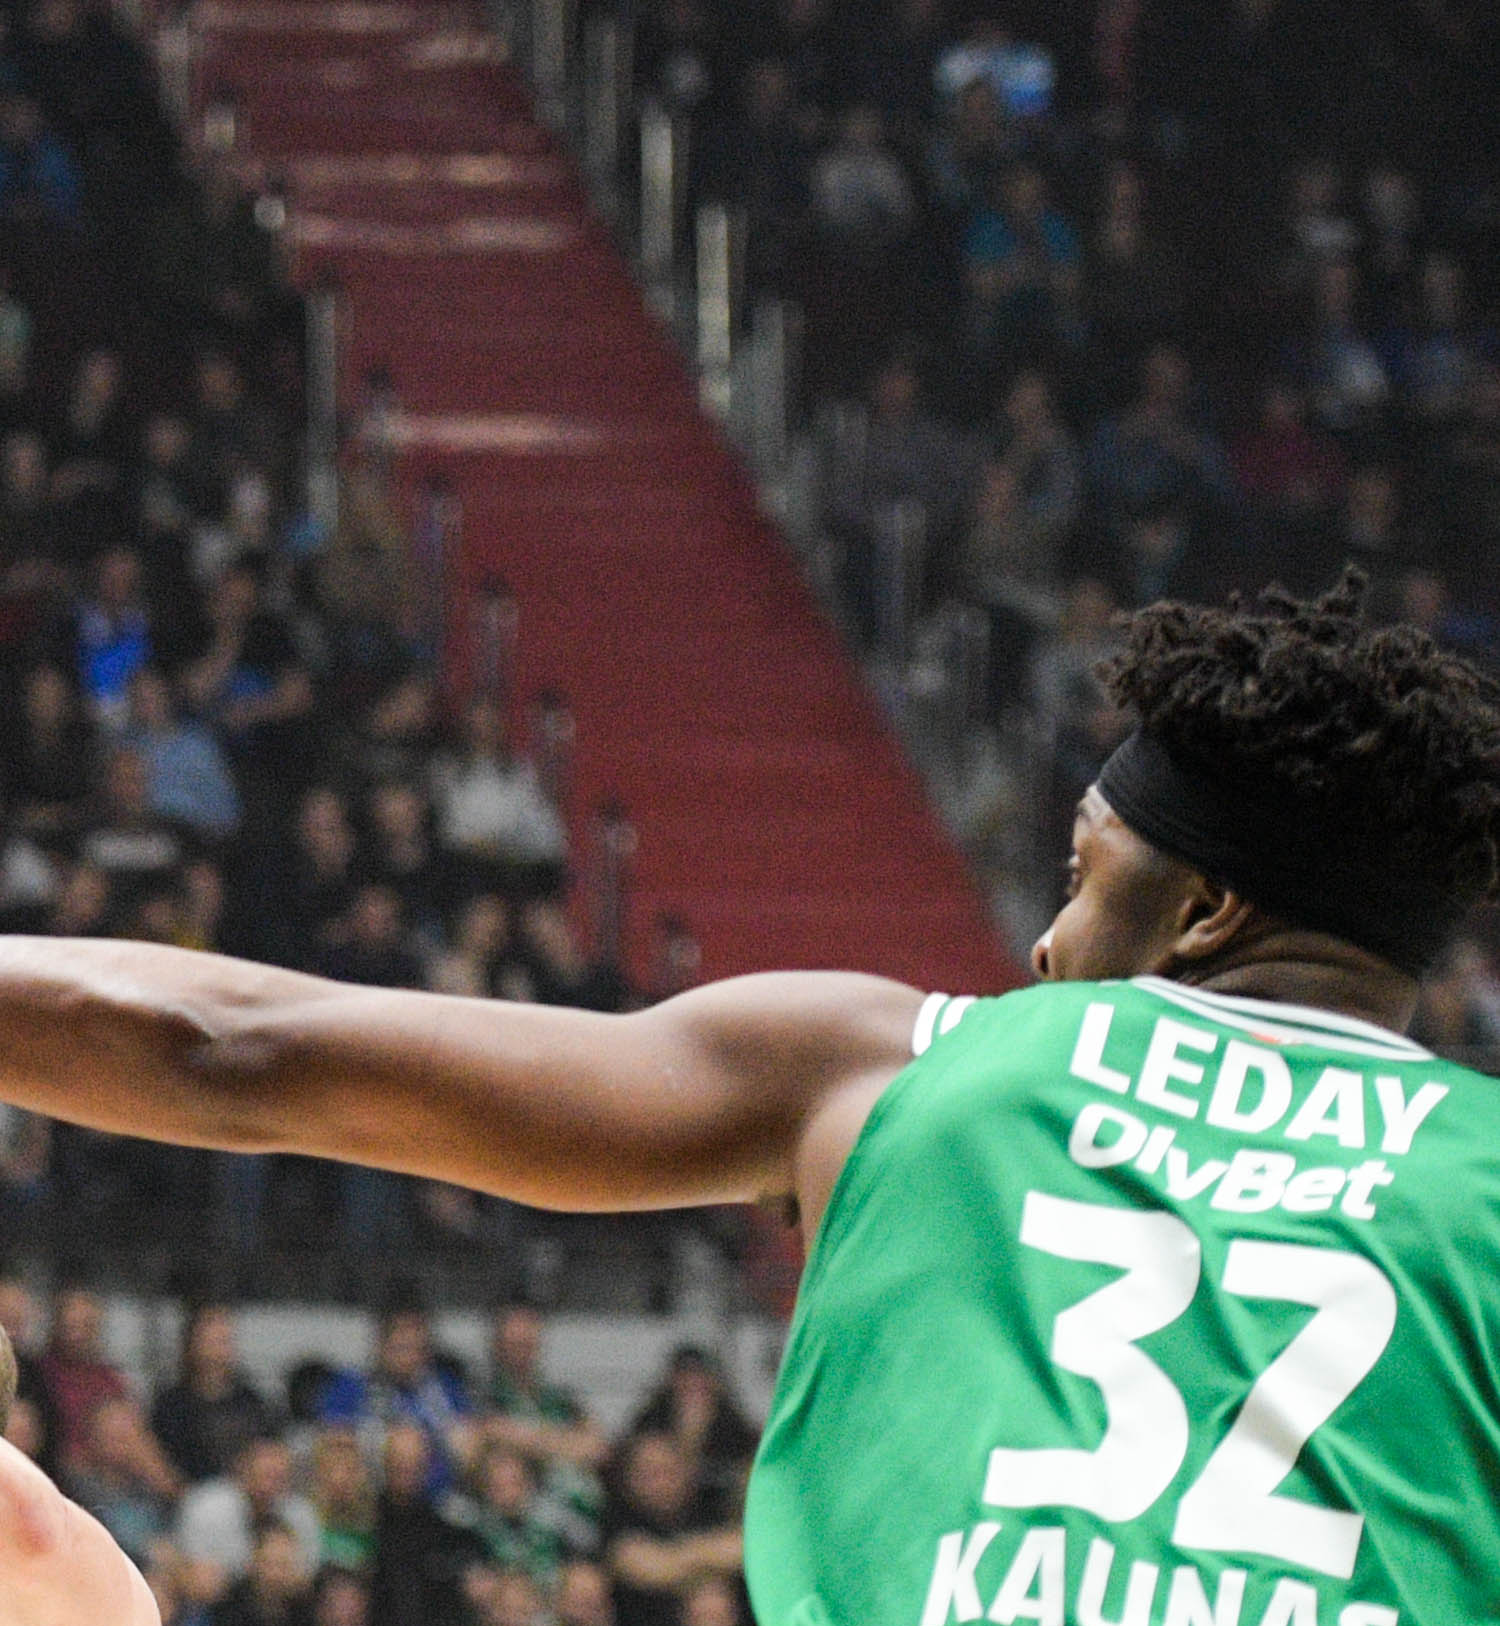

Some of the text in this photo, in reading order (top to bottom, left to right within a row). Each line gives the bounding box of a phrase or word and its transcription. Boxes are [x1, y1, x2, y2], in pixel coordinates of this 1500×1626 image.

[1069, 1002, 1450, 1155] LEDAY
[1069, 1103, 1395, 1220] OlyBet
[982, 1189, 1398, 1579] 32
